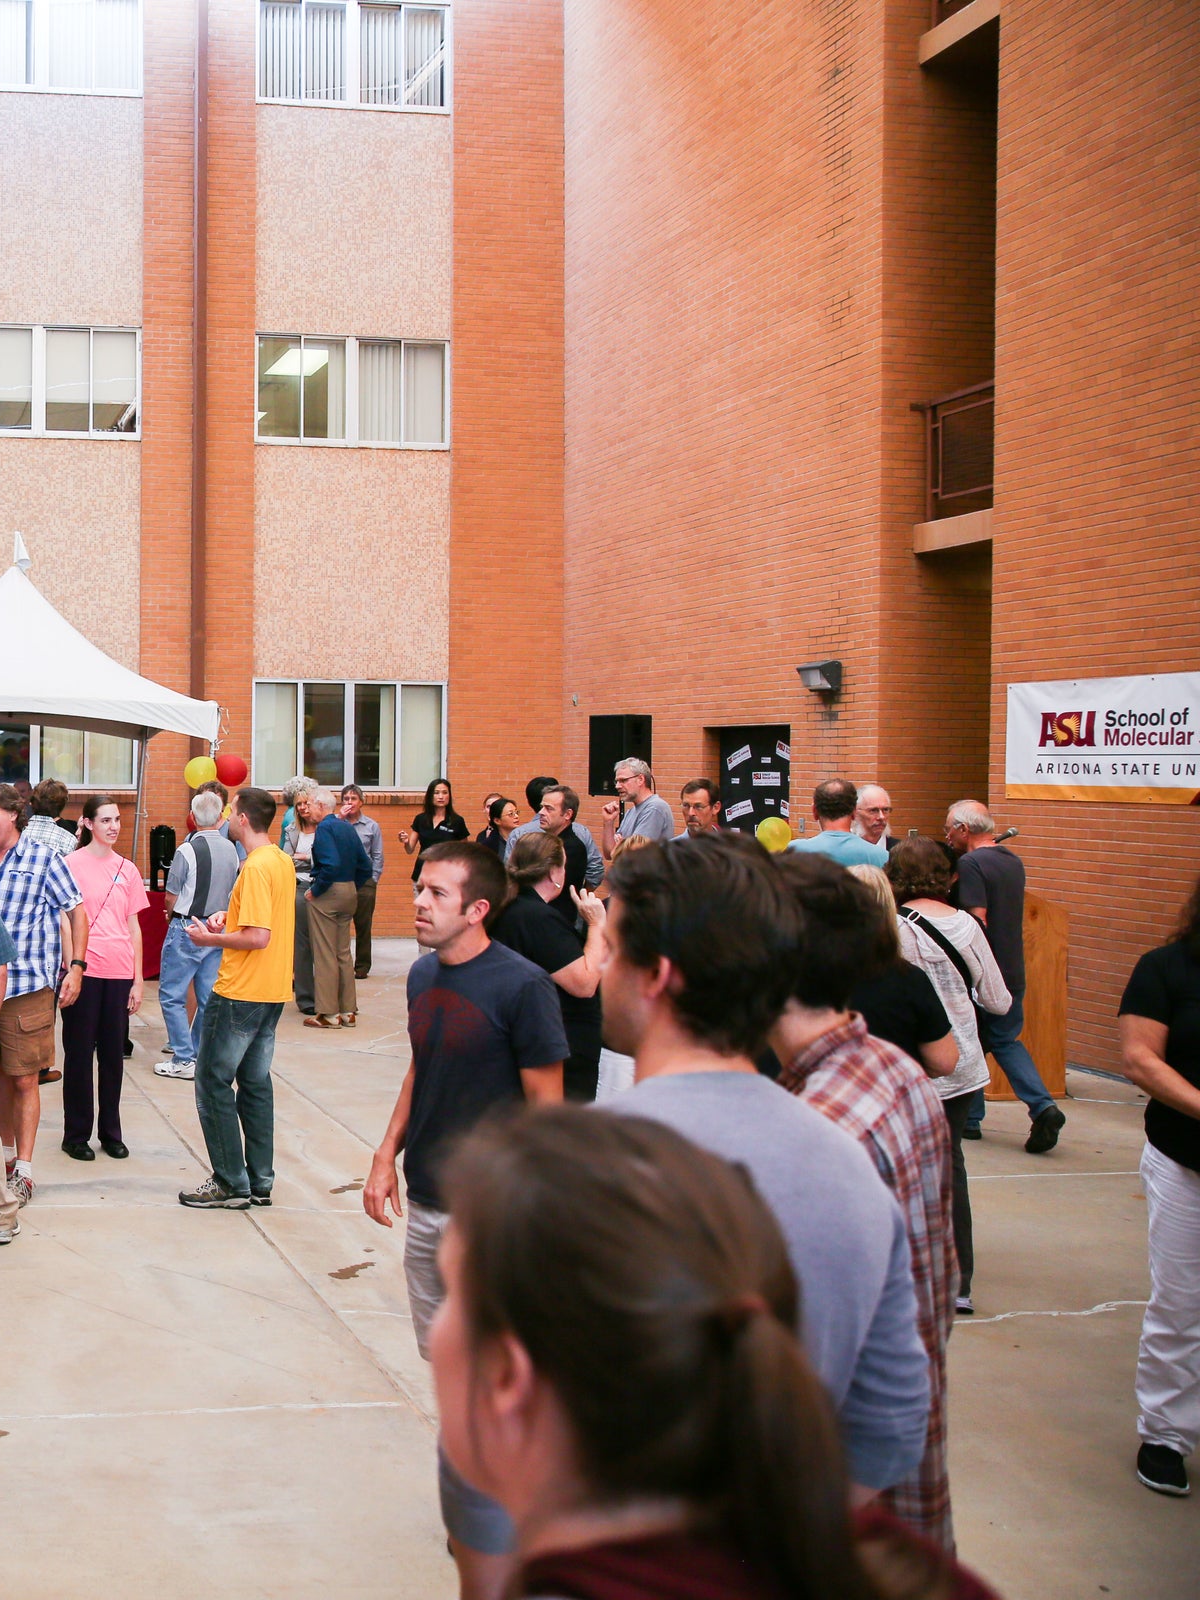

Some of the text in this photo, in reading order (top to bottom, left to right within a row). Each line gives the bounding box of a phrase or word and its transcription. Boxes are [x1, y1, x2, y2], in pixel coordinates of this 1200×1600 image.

[1105, 707, 1189, 727] School of
[1038, 711, 1096, 747] ASU
[1104, 727, 1194, 746] Molecular
[1035, 763, 1101, 774] ARIZONA
[1111, 763, 1160, 775] STATE
